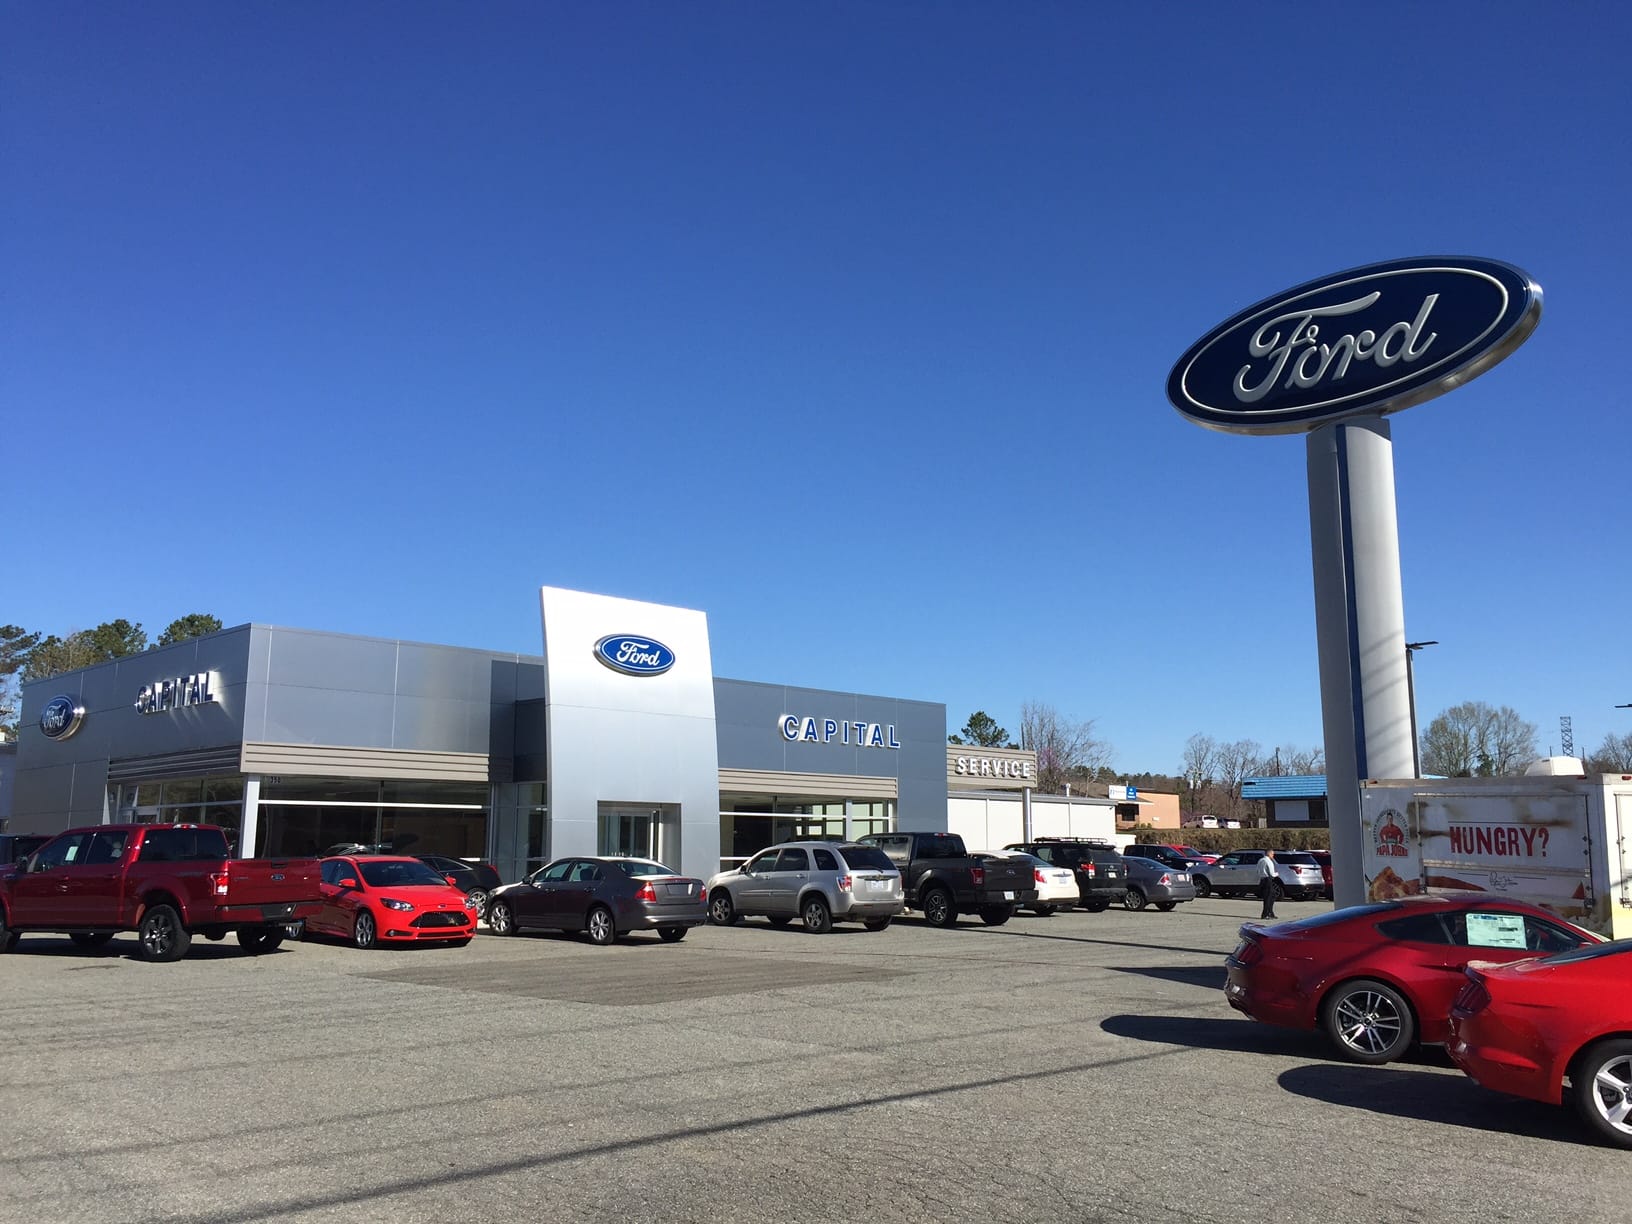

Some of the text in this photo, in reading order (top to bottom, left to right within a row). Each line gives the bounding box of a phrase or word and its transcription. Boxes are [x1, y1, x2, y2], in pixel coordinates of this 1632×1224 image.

[1232, 290, 1441, 403] Ford
[616, 641, 661, 666] Ford
[136, 671, 215, 716] CAPITAL
[43, 703, 67, 729] Ford
[780, 714, 901, 749] CAPITAL
[957, 756, 1032, 777] SERVICE
[1449, 826, 1550, 857] HUNGRY?
